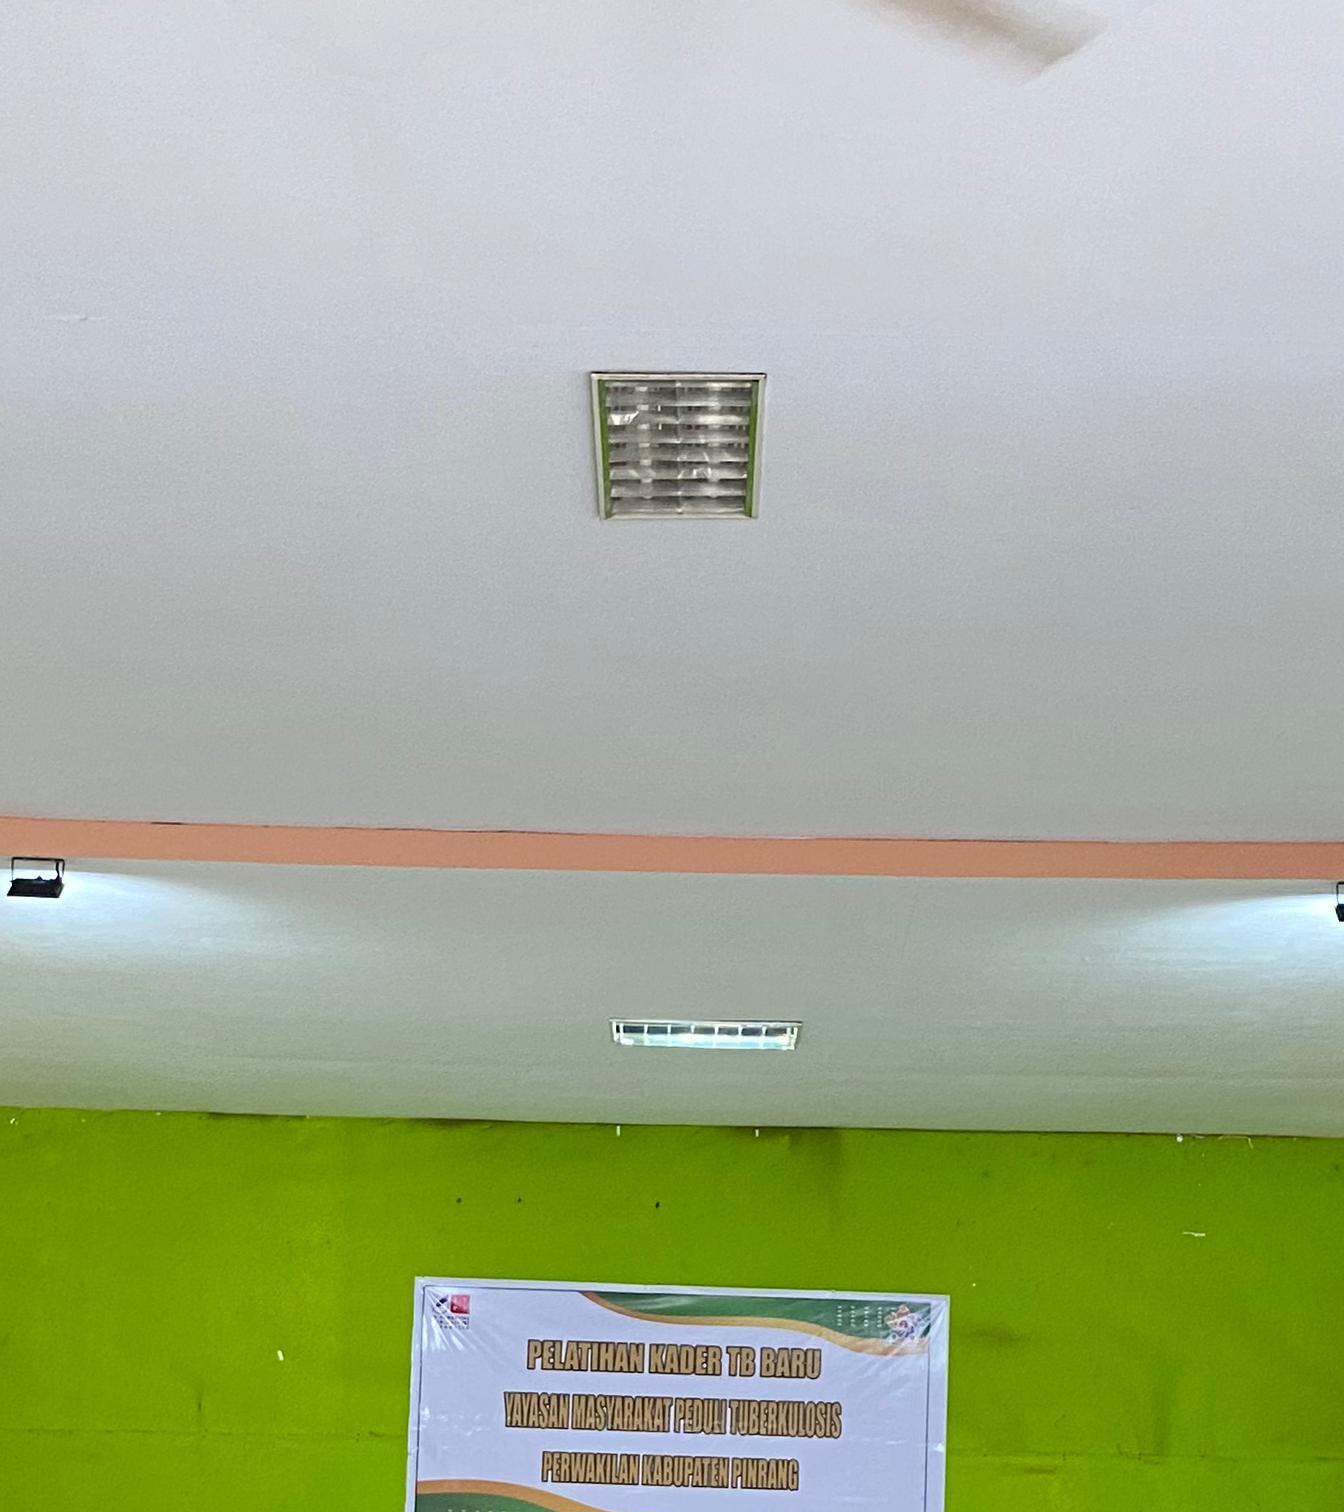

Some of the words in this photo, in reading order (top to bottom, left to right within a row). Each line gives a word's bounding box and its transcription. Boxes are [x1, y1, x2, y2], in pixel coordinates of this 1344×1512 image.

[527, 1339, 645, 1374] PELATIHAN
[649, 1343, 722, 1376] KADER
[726, 1346, 755, 1377] TB
[760, 1347, 822, 1379] BARU
[504, 1391, 570, 1429] YAYASAN
[571, 1393, 673, 1433] MASYARAKAT
[674, 1396, 727, 1435] PEDULI
[729, 1398, 842, 1439] TUBERKULOSIS
[541, 1450, 639, 1486] PERWAKILAN
[641, 1453, 729, 1489] KABUPATEN
[731, 1457, 800, 1491] PINRANG
